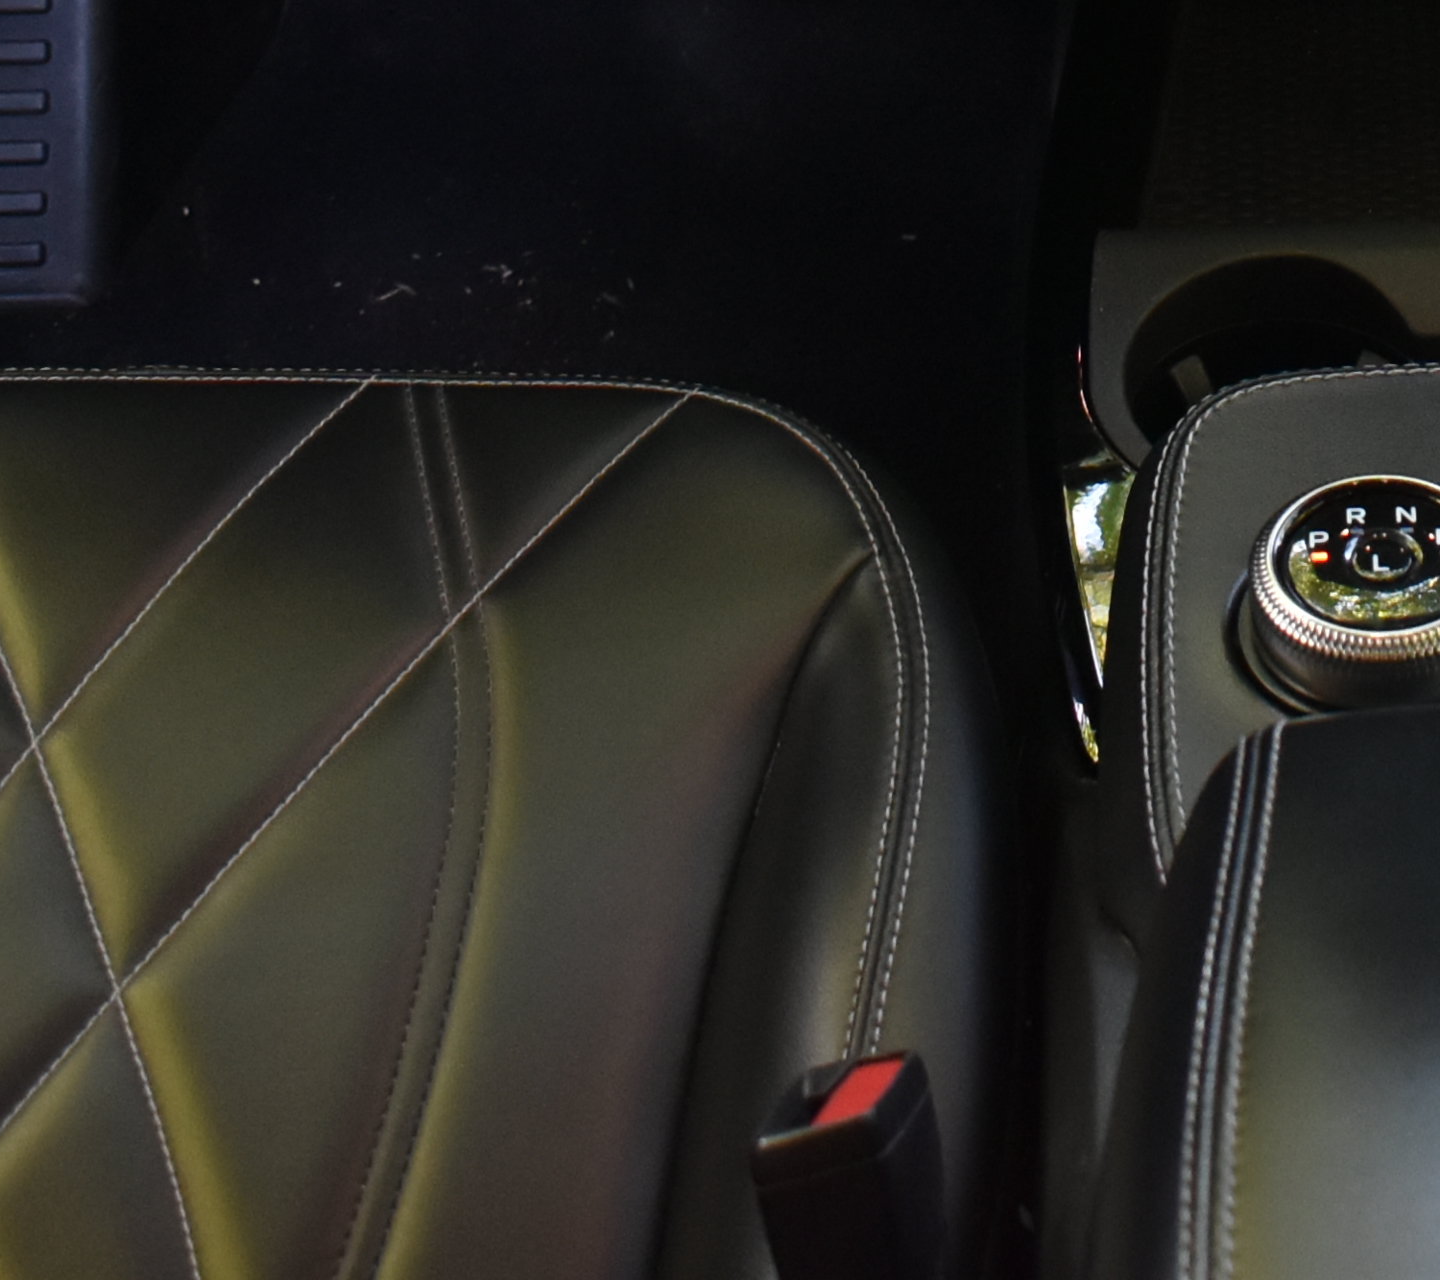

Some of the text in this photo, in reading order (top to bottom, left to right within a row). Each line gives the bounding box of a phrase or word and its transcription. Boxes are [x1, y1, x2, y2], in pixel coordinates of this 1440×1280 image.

[1346, 506, 1417, 524] R N
[1309, 530, 1329, 548] P
[1372, 554, 1390, 572] L
